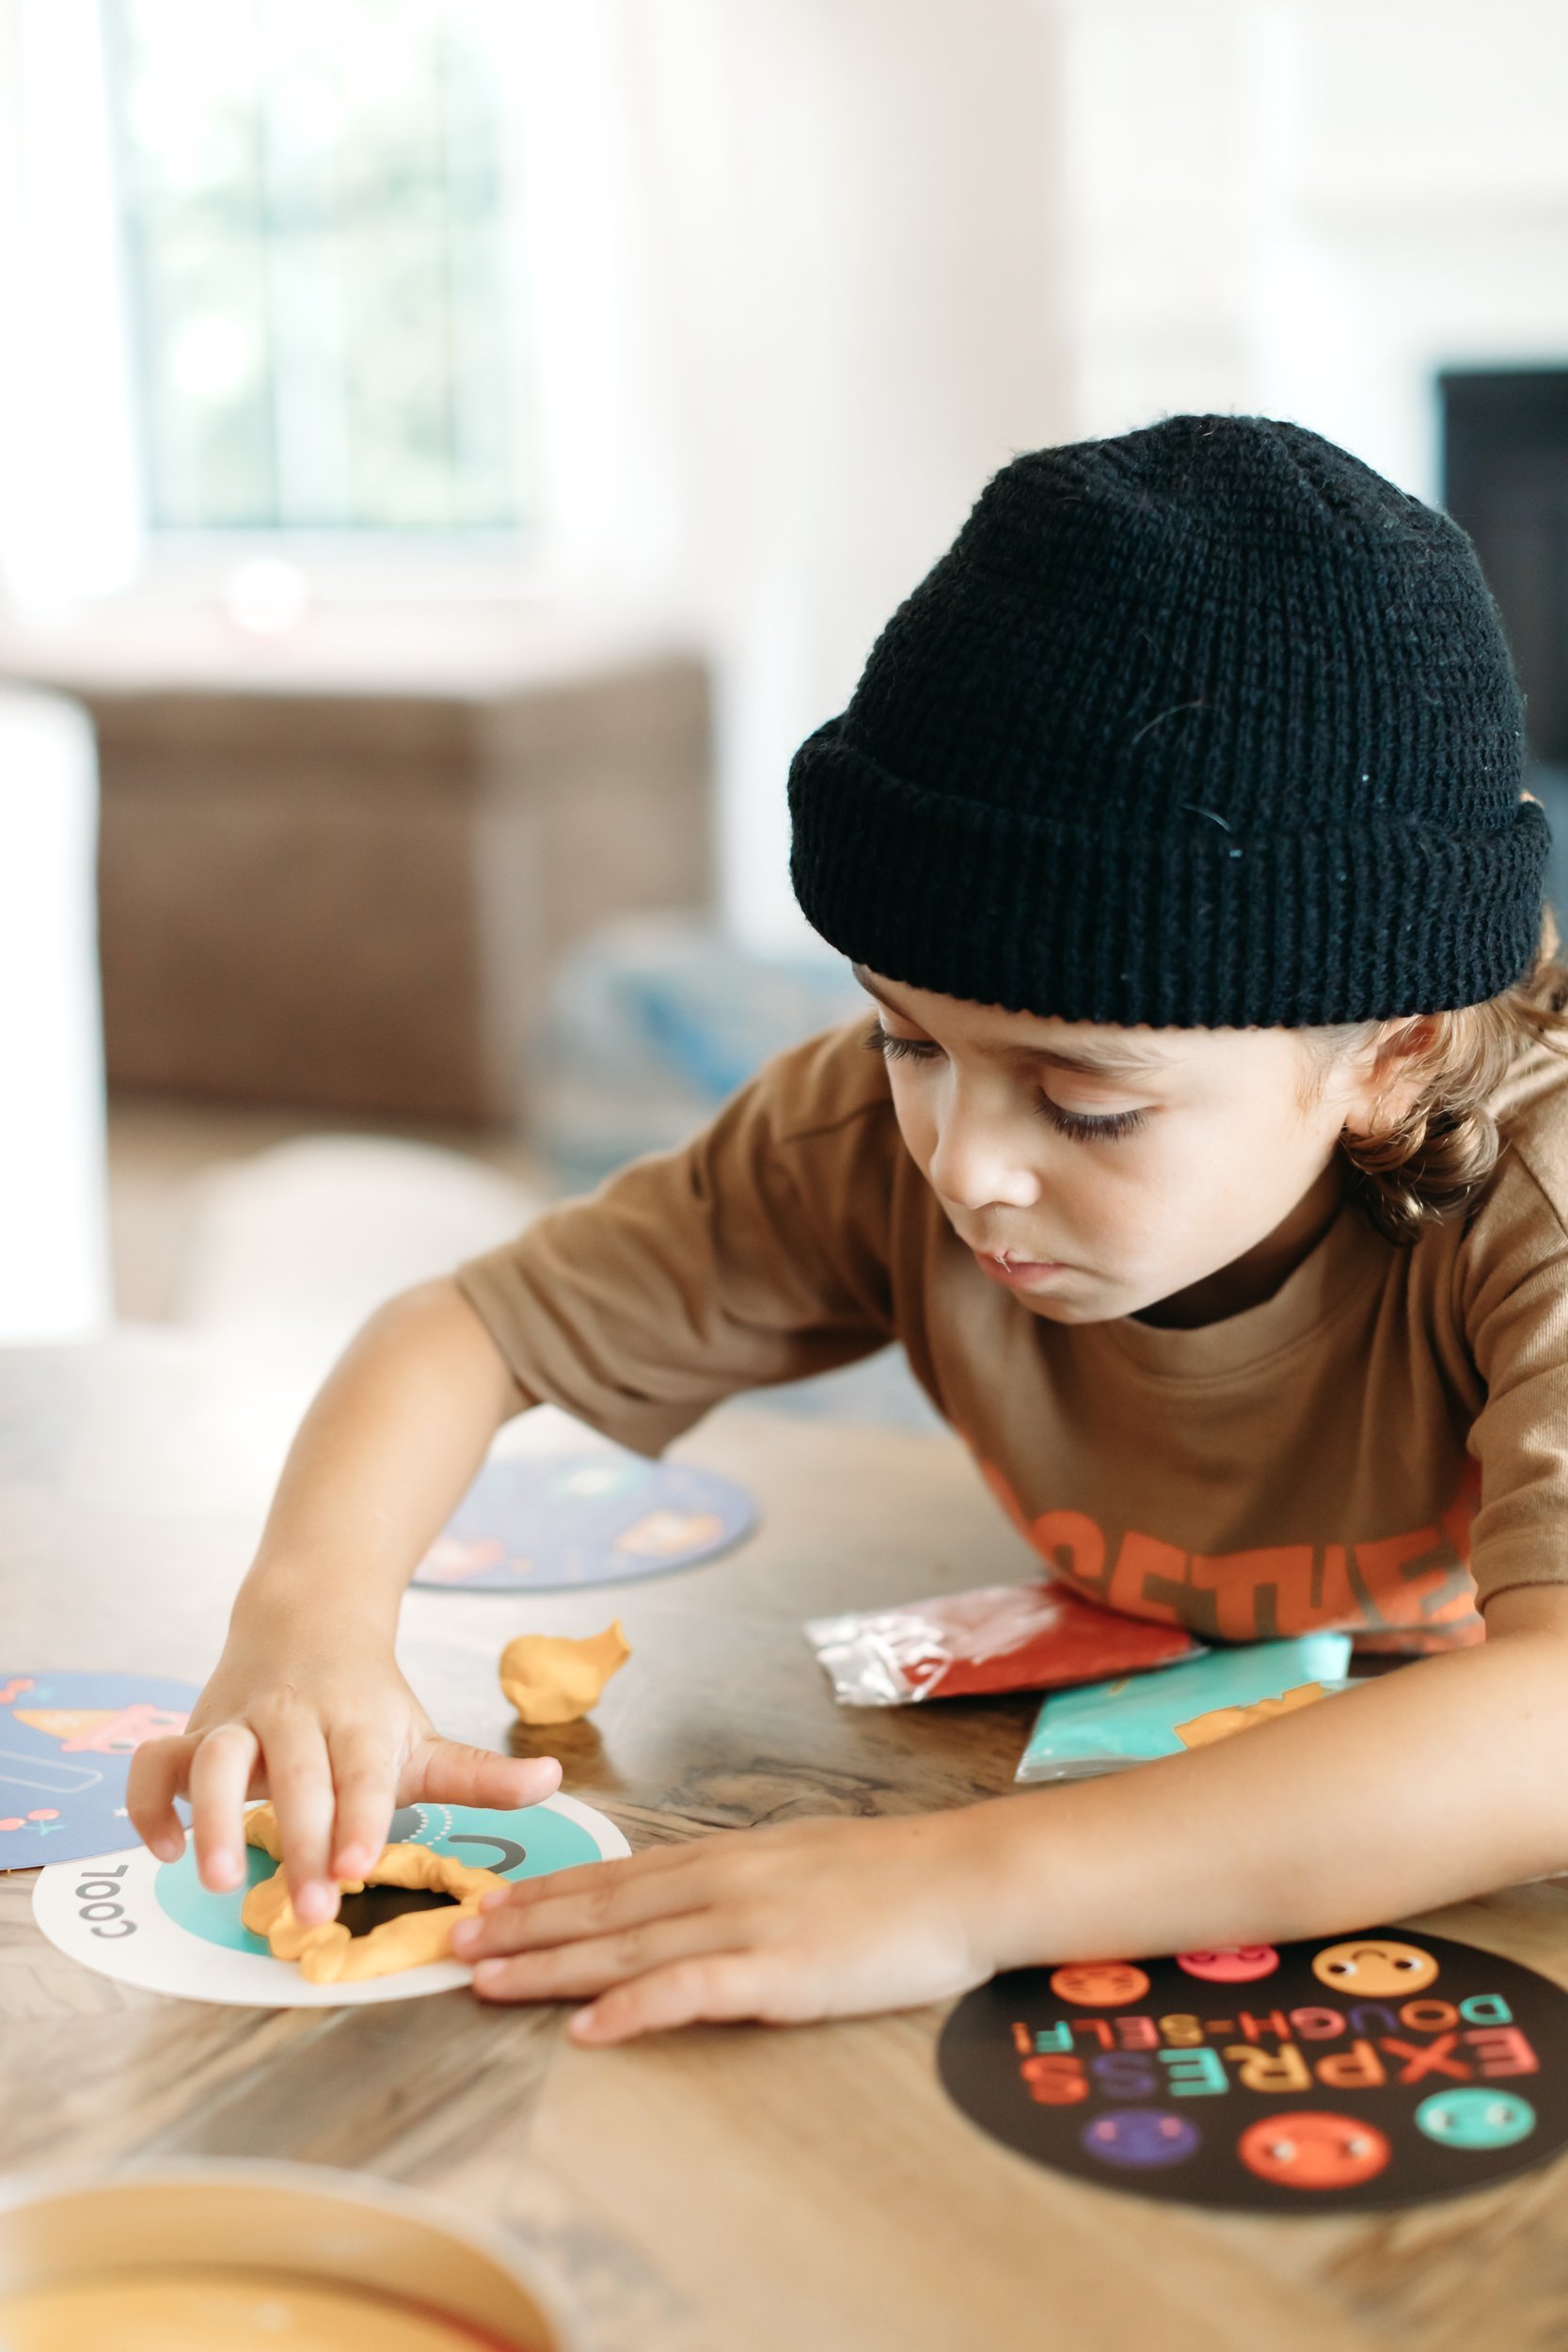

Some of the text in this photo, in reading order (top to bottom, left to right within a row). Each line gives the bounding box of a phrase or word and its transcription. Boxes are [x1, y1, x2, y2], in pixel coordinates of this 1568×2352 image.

[75, 1865, 138, 1939] COOL
[1012, 1994, 1513, 2054] DOUGH-SELF!
[1021, 2026, 1540, 2106] EXPRESS
